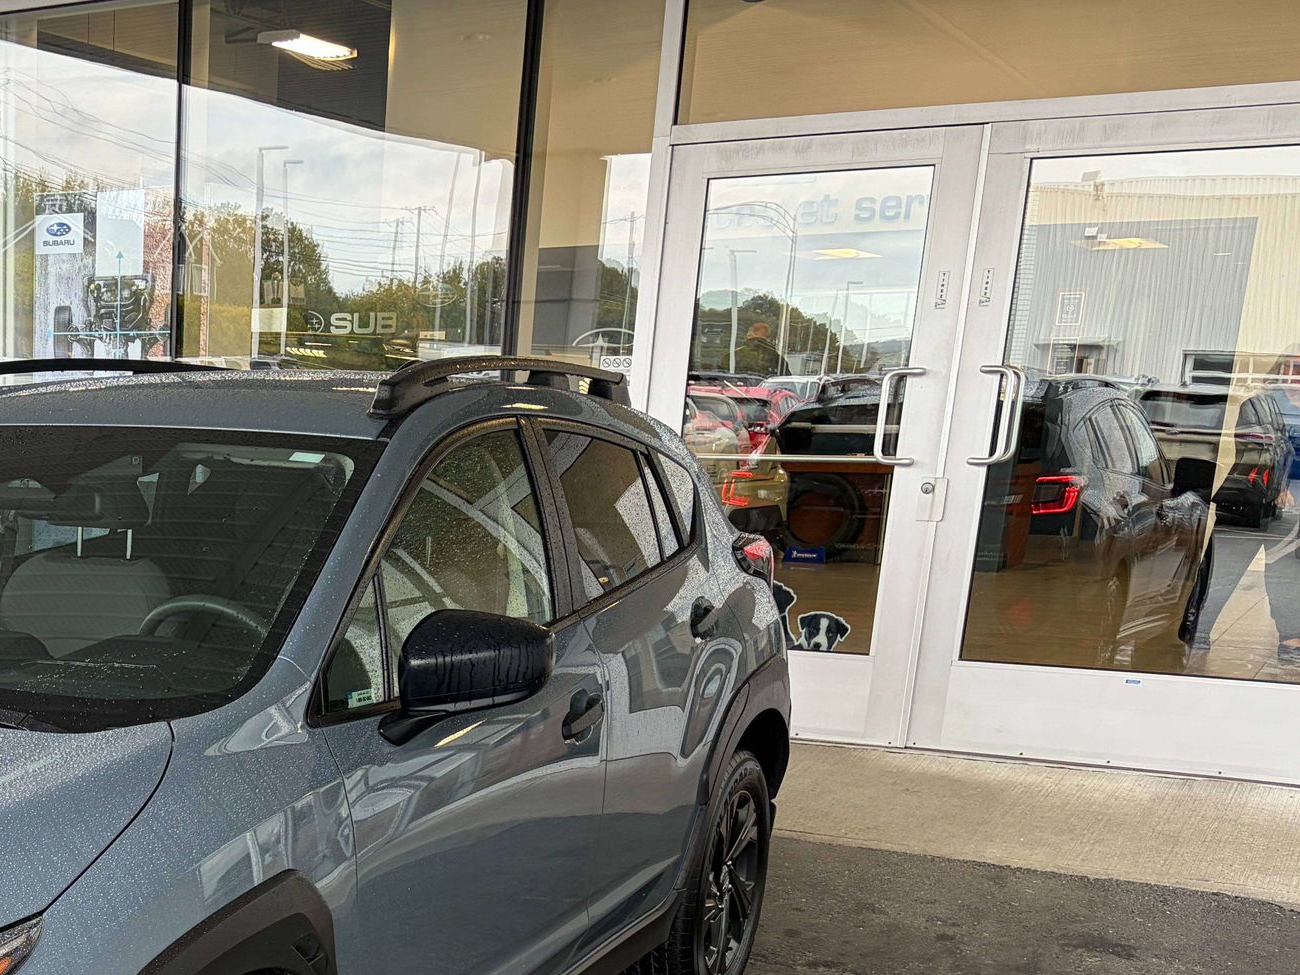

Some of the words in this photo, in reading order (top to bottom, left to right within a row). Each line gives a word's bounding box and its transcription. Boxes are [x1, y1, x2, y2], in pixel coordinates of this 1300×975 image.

[797, 194, 839, 225] et
[853, 194, 930, 225] ser
[42, 239, 75, 247] SUBARU
